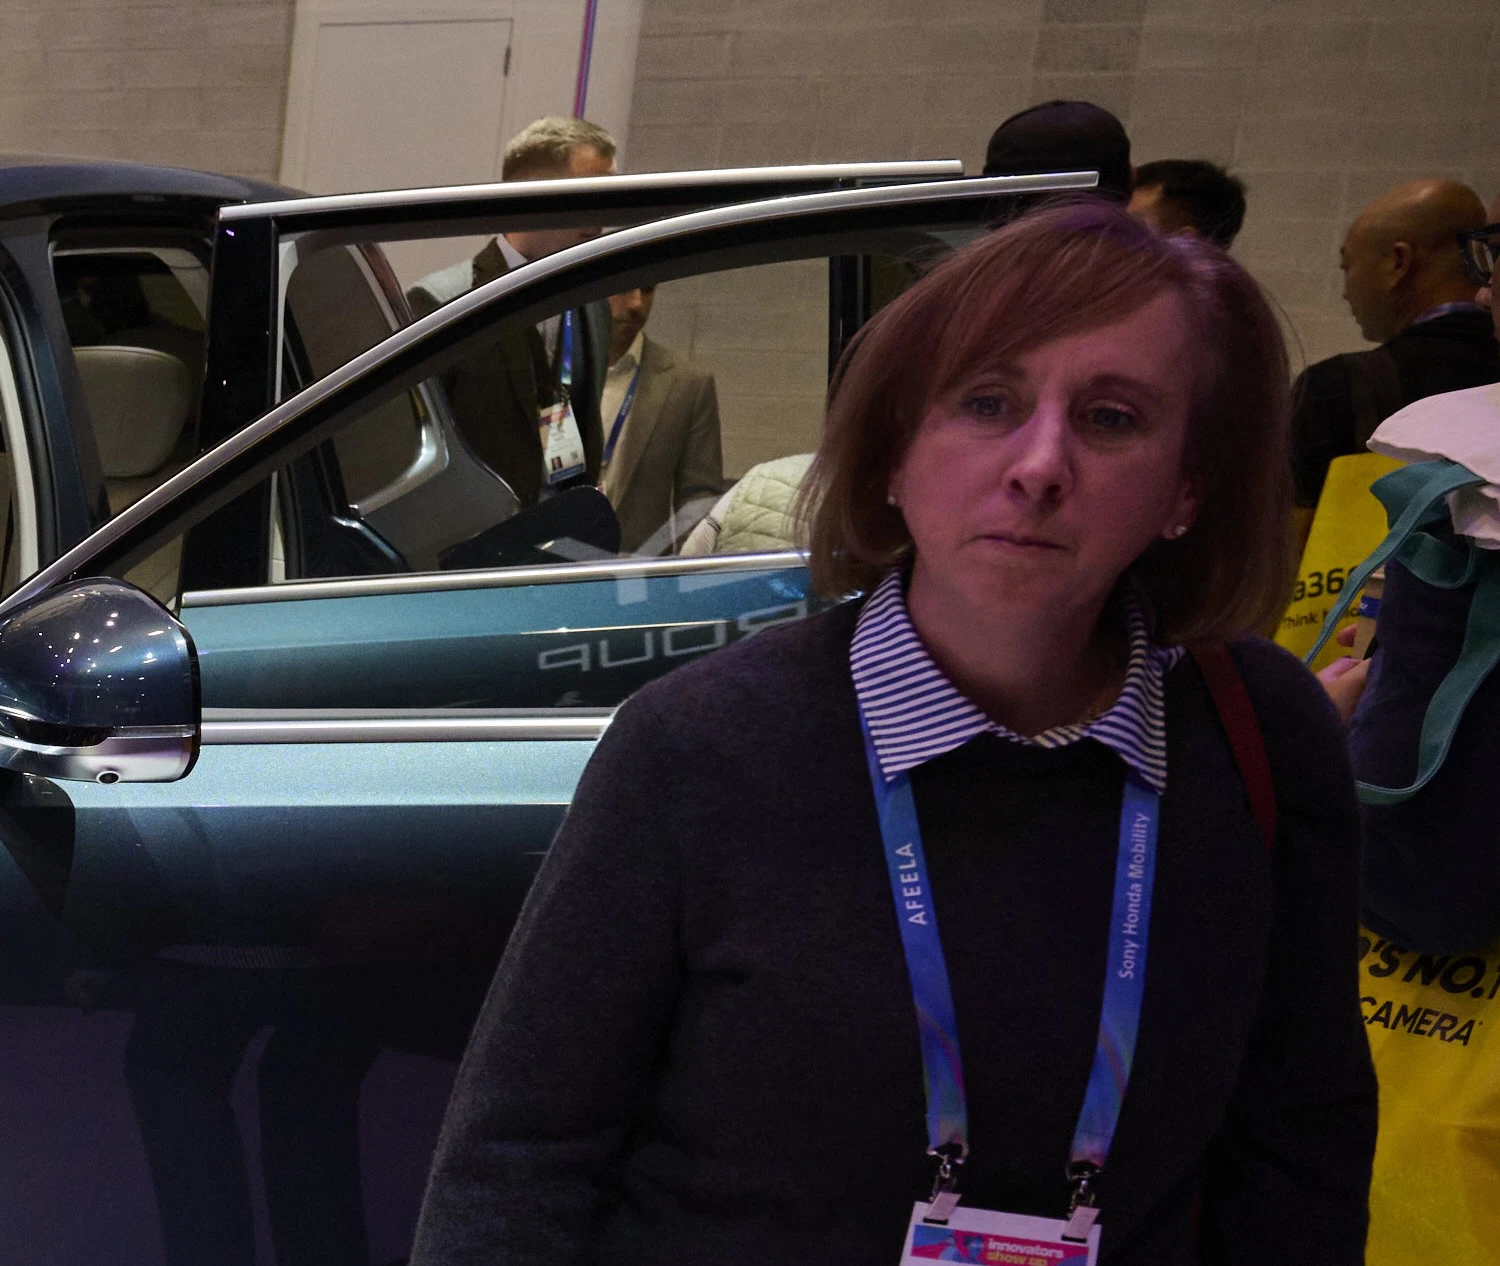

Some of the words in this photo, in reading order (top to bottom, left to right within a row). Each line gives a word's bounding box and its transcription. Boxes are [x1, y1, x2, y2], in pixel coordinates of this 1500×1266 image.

[1128, 812, 1151, 879] Mobility
[895, 843, 928, 925] AFEELA
[1122, 883, 1143, 935] Honda
[1118, 939, 1140, 980] Sony
[986, 1251, 1026, 1265] show
[988, 1238, 1064, 1259] innovators
